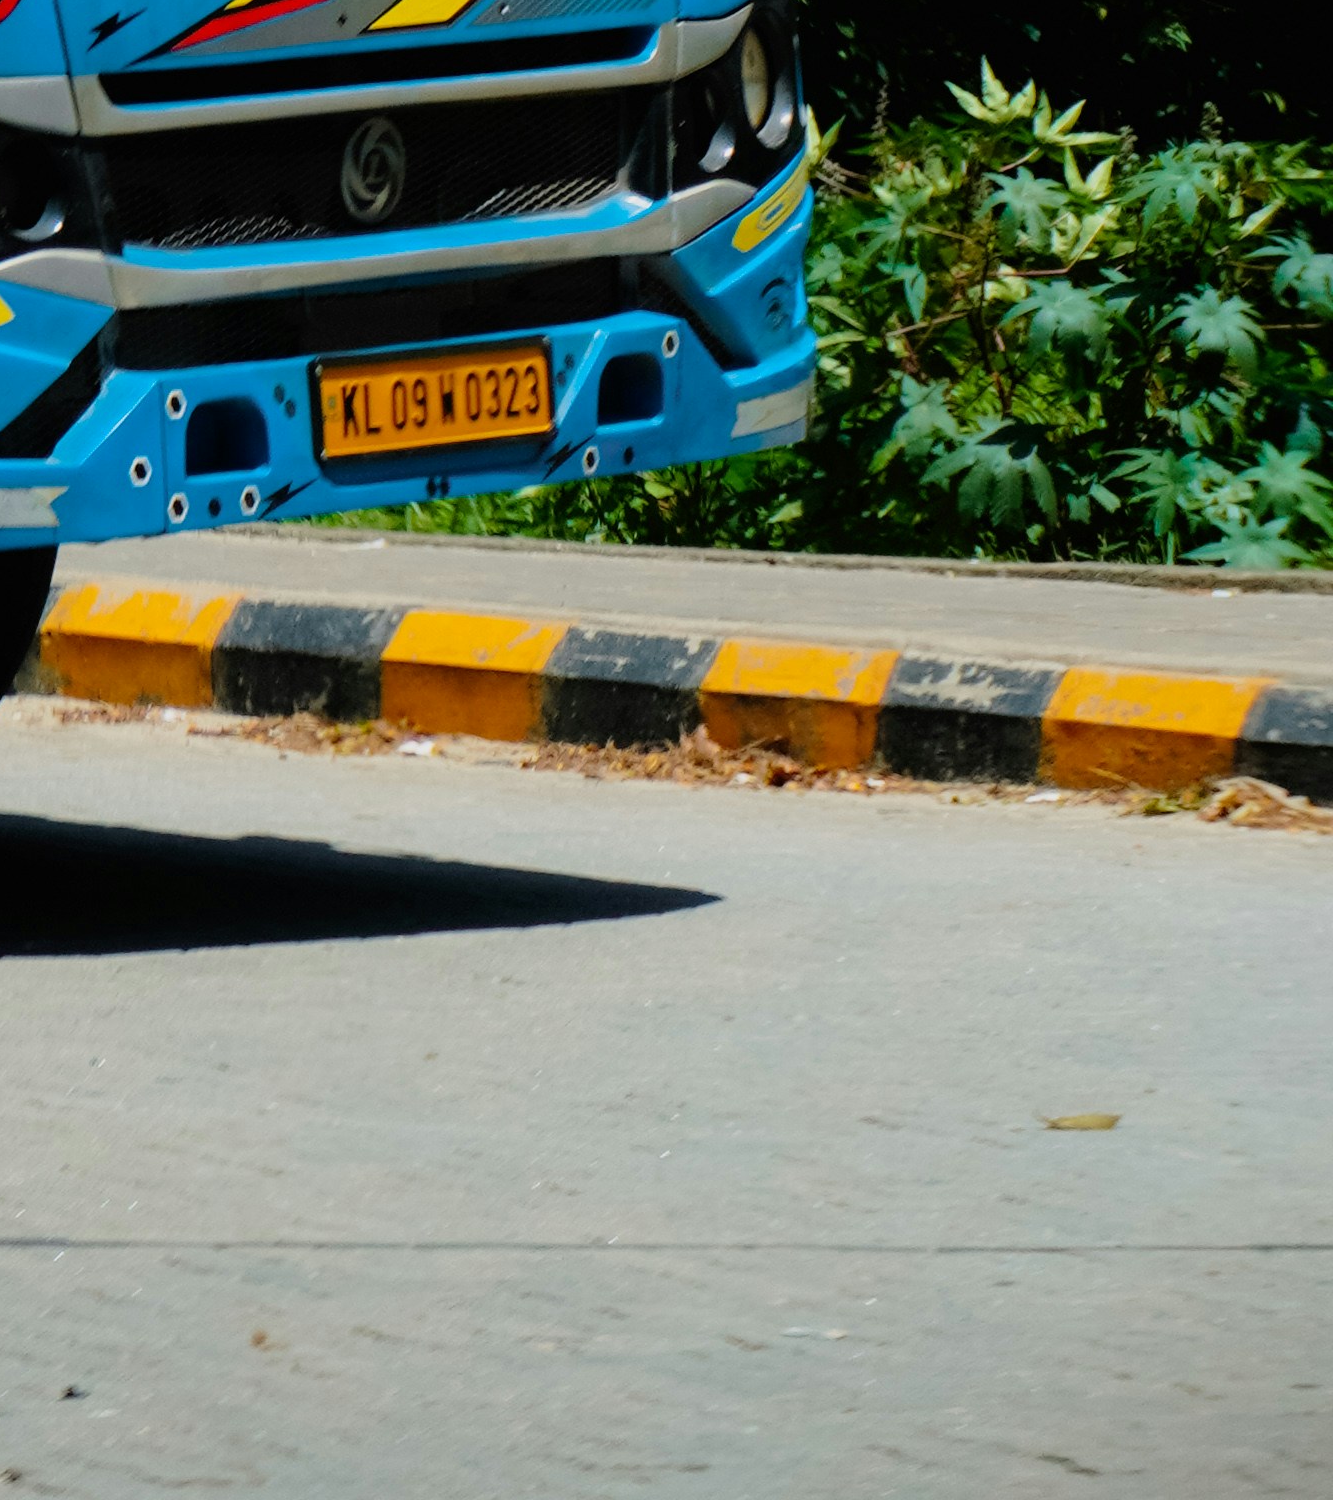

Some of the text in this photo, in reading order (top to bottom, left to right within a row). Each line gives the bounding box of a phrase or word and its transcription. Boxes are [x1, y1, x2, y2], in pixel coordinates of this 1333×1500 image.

[341, 382, 380, 437] KL
[392, 378, 427, 430] 09
[465, 364, 541, 421] 0323
